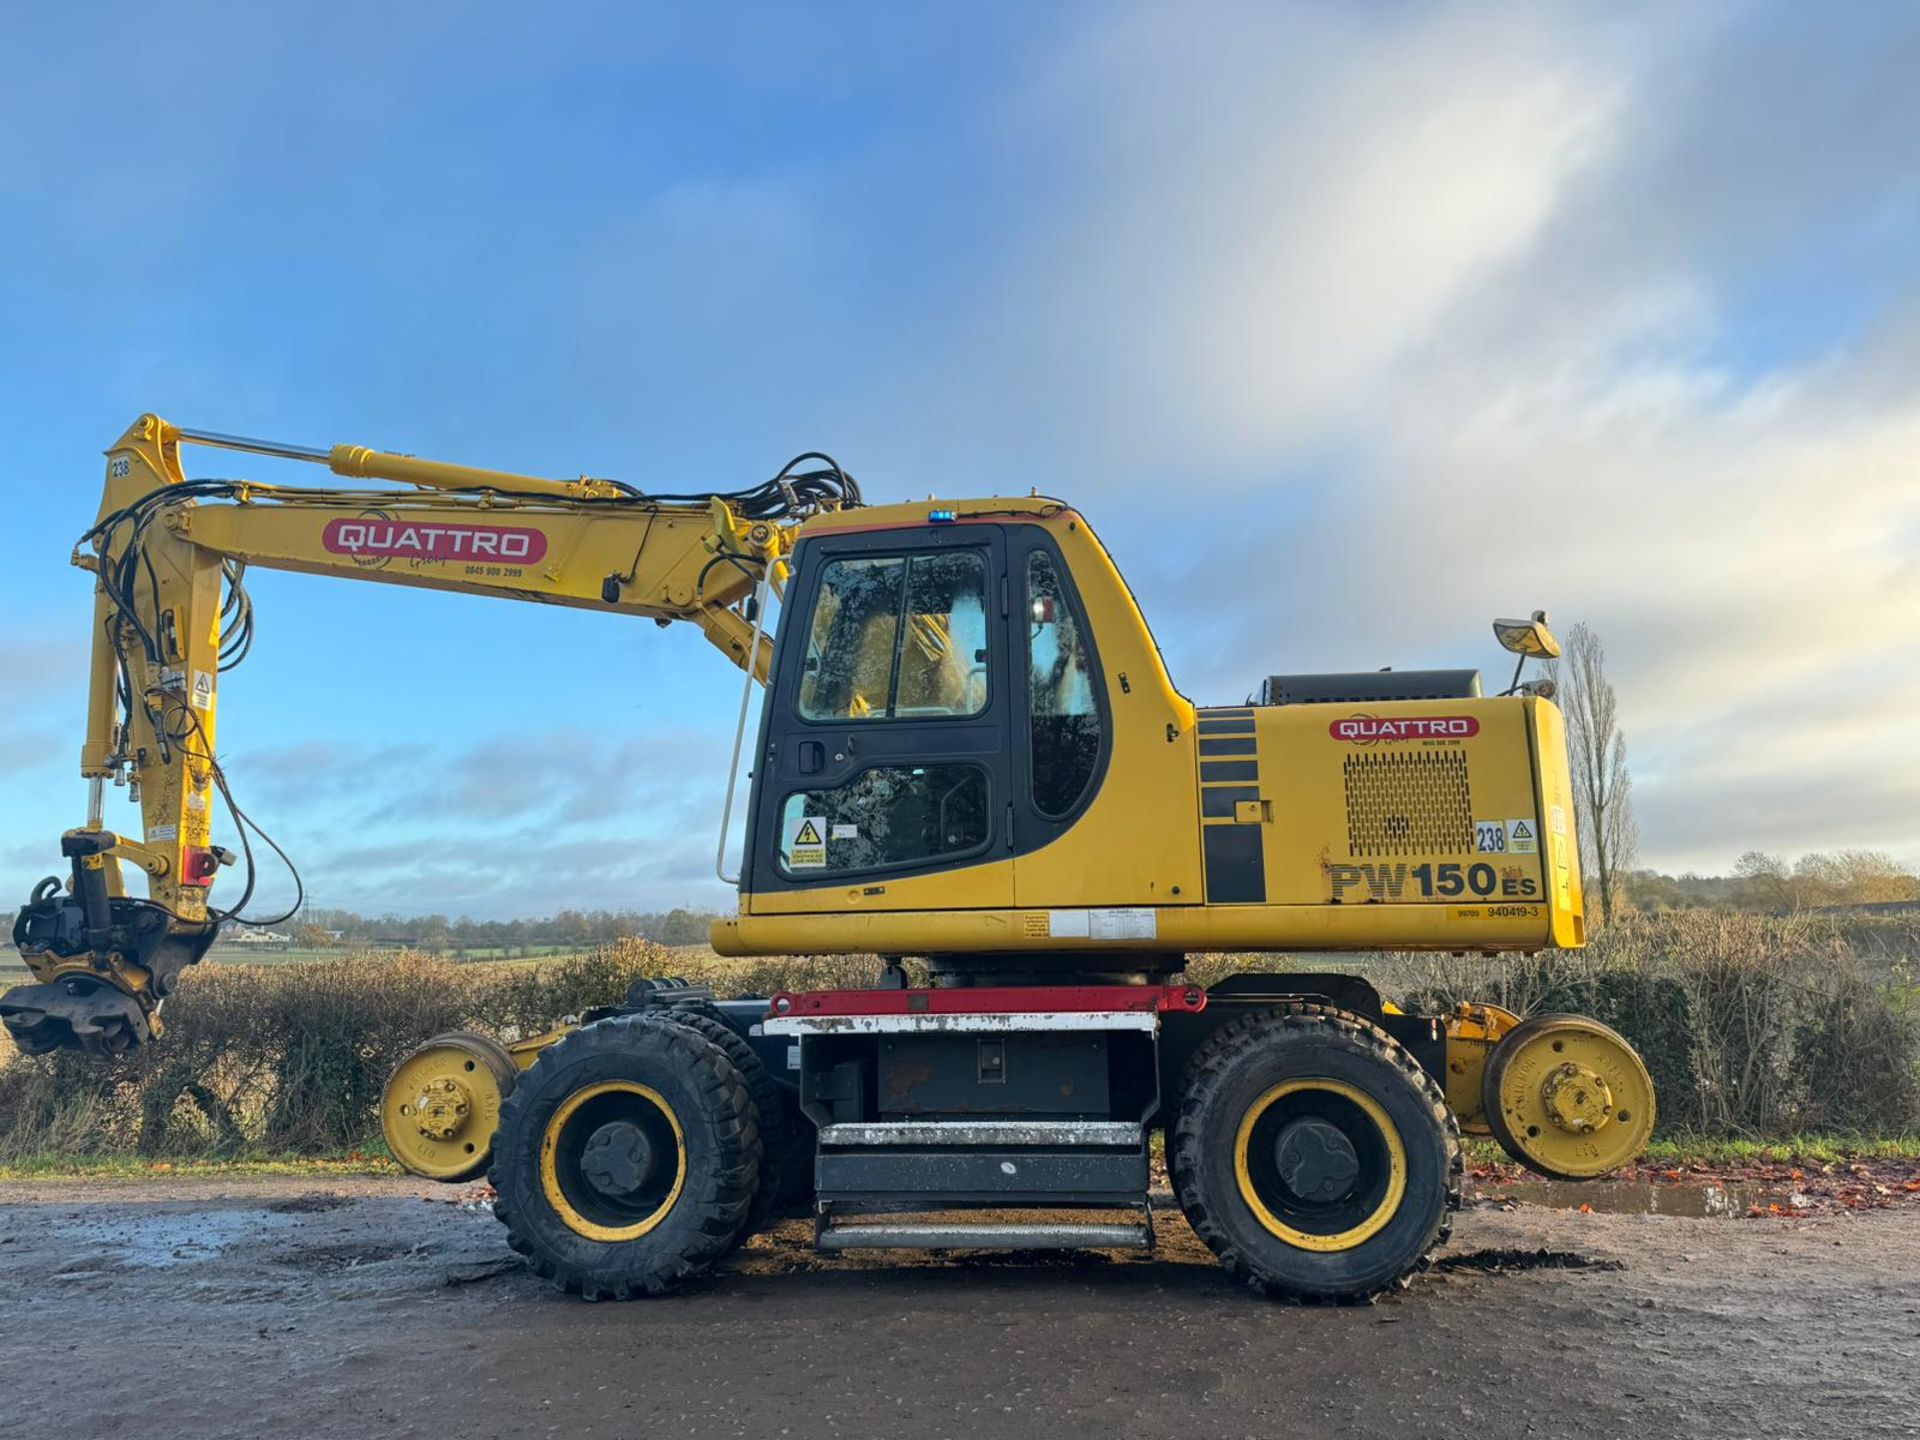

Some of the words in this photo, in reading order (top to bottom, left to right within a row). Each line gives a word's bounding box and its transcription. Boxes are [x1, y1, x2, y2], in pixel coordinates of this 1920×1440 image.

[113, 460, 129, 477] 238
[337, 524, 530, 557] QUATTRO
[1339, 719, 1469, 738] QUATTRO
[1477, 827, 1505, 852] 238
[1487, 906, 1539, 918] 940419-3
